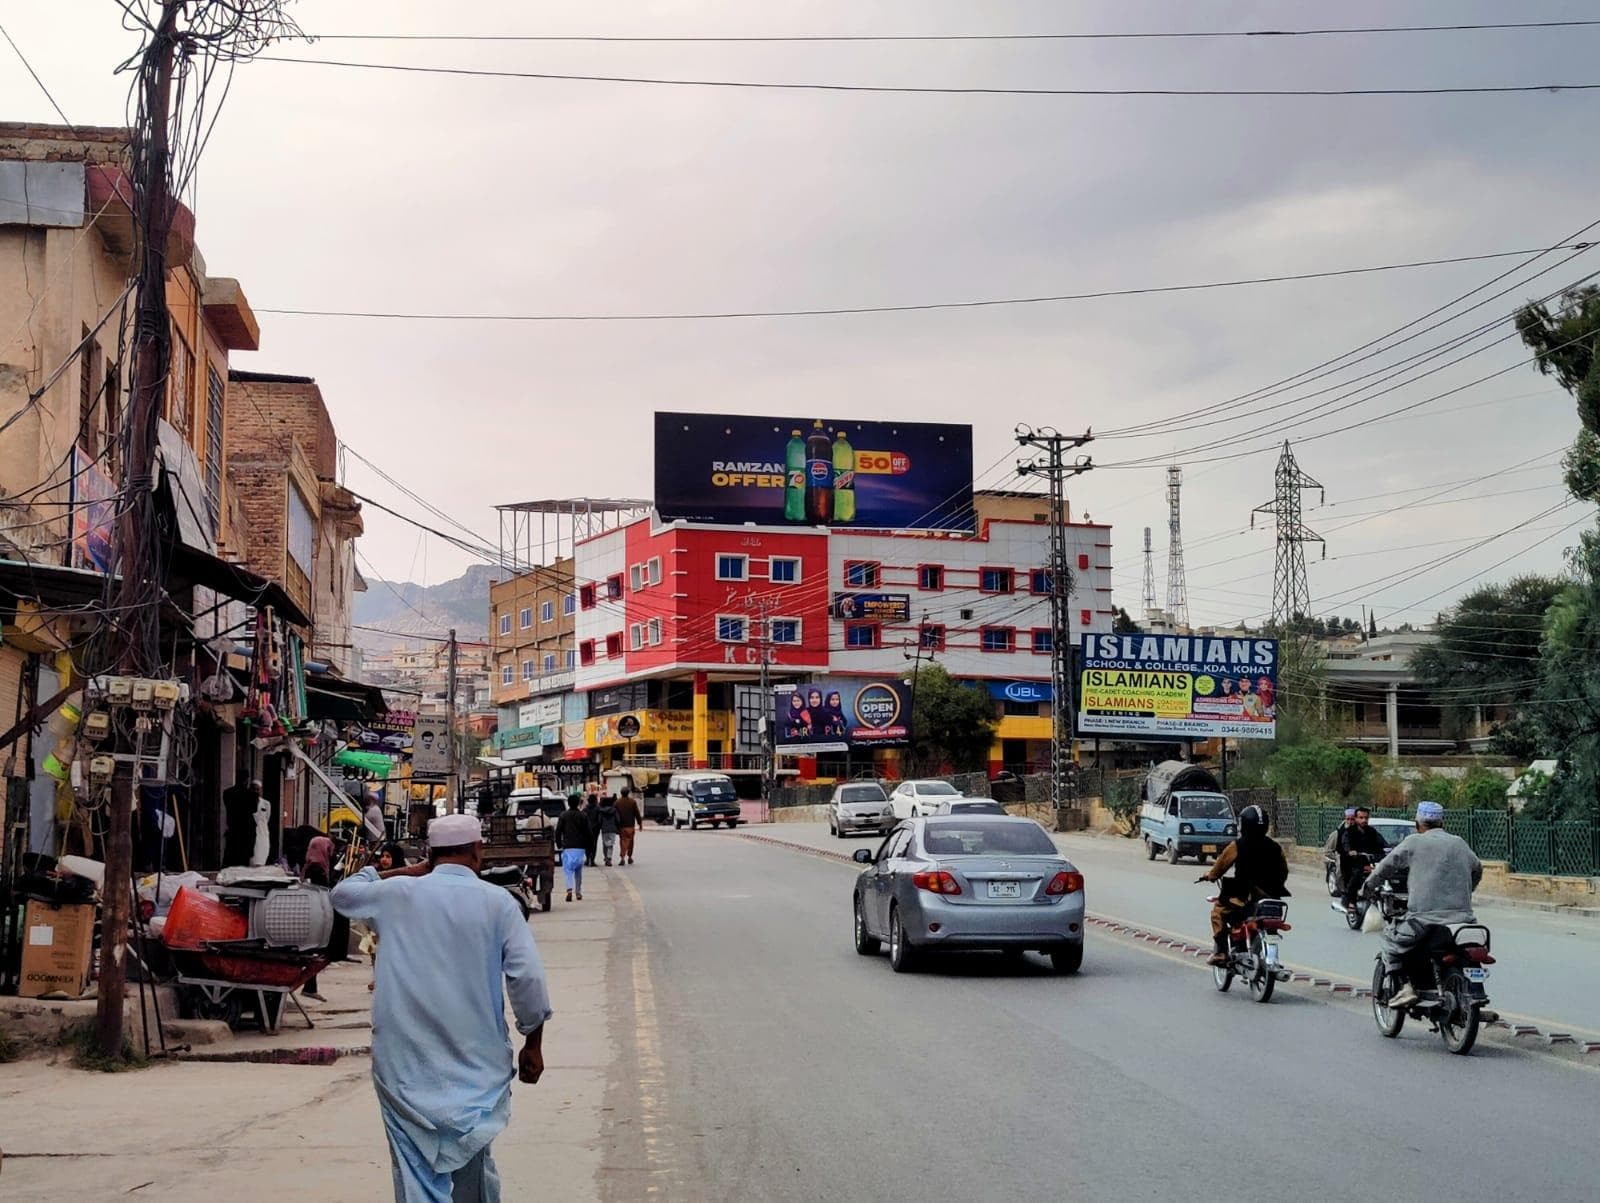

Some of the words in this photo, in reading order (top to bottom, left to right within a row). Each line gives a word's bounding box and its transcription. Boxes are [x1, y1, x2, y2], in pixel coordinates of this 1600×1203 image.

[712, 461, 786, 473] RAMZAN
[860, 457, 890, 470] 50
[892, 457, 907, 466] OFF
[711, 473, 785, 488] OFFER
[1085, 634, 1274, 665] ISLAMIANS
[1085, 660, 1133, 670] SCHOOL
[1134, 661, 1143, 670] &
[1233, 665, 1272, 674] KOHAT
[1086, 671, 1189, 690] ISLAMIANS
[1010, 687, 1042, 698] UBL
[1122, 689, 1156, 697] COACHING
[1156, 691, 1188, 699] ACADEMY
[861, 703, 893, 713] OPEN
[1084, 696, 1155, 710] ISLAMIANS
[532, 764, 556, 773] PEARL
[560, 764, 584, 773] OASIS
